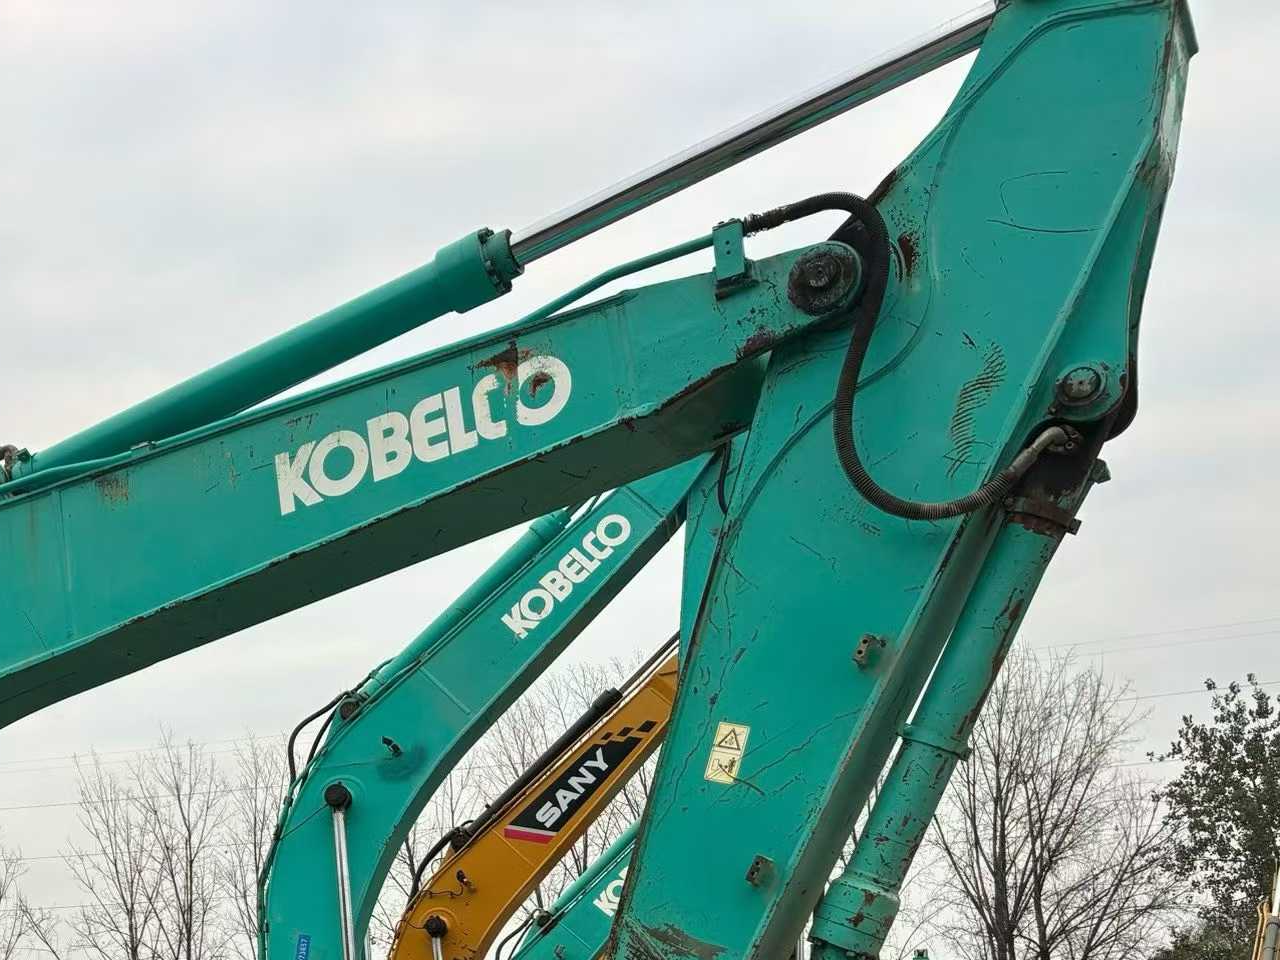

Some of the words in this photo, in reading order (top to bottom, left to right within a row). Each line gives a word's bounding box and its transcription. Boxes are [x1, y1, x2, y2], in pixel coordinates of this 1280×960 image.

[275, 355, 572, 516] KOBELCO
[501, 514, 631, 640] KOBELCO
[536, 747, 609, 829] SANY
[593, 865, 629, 917] KO
